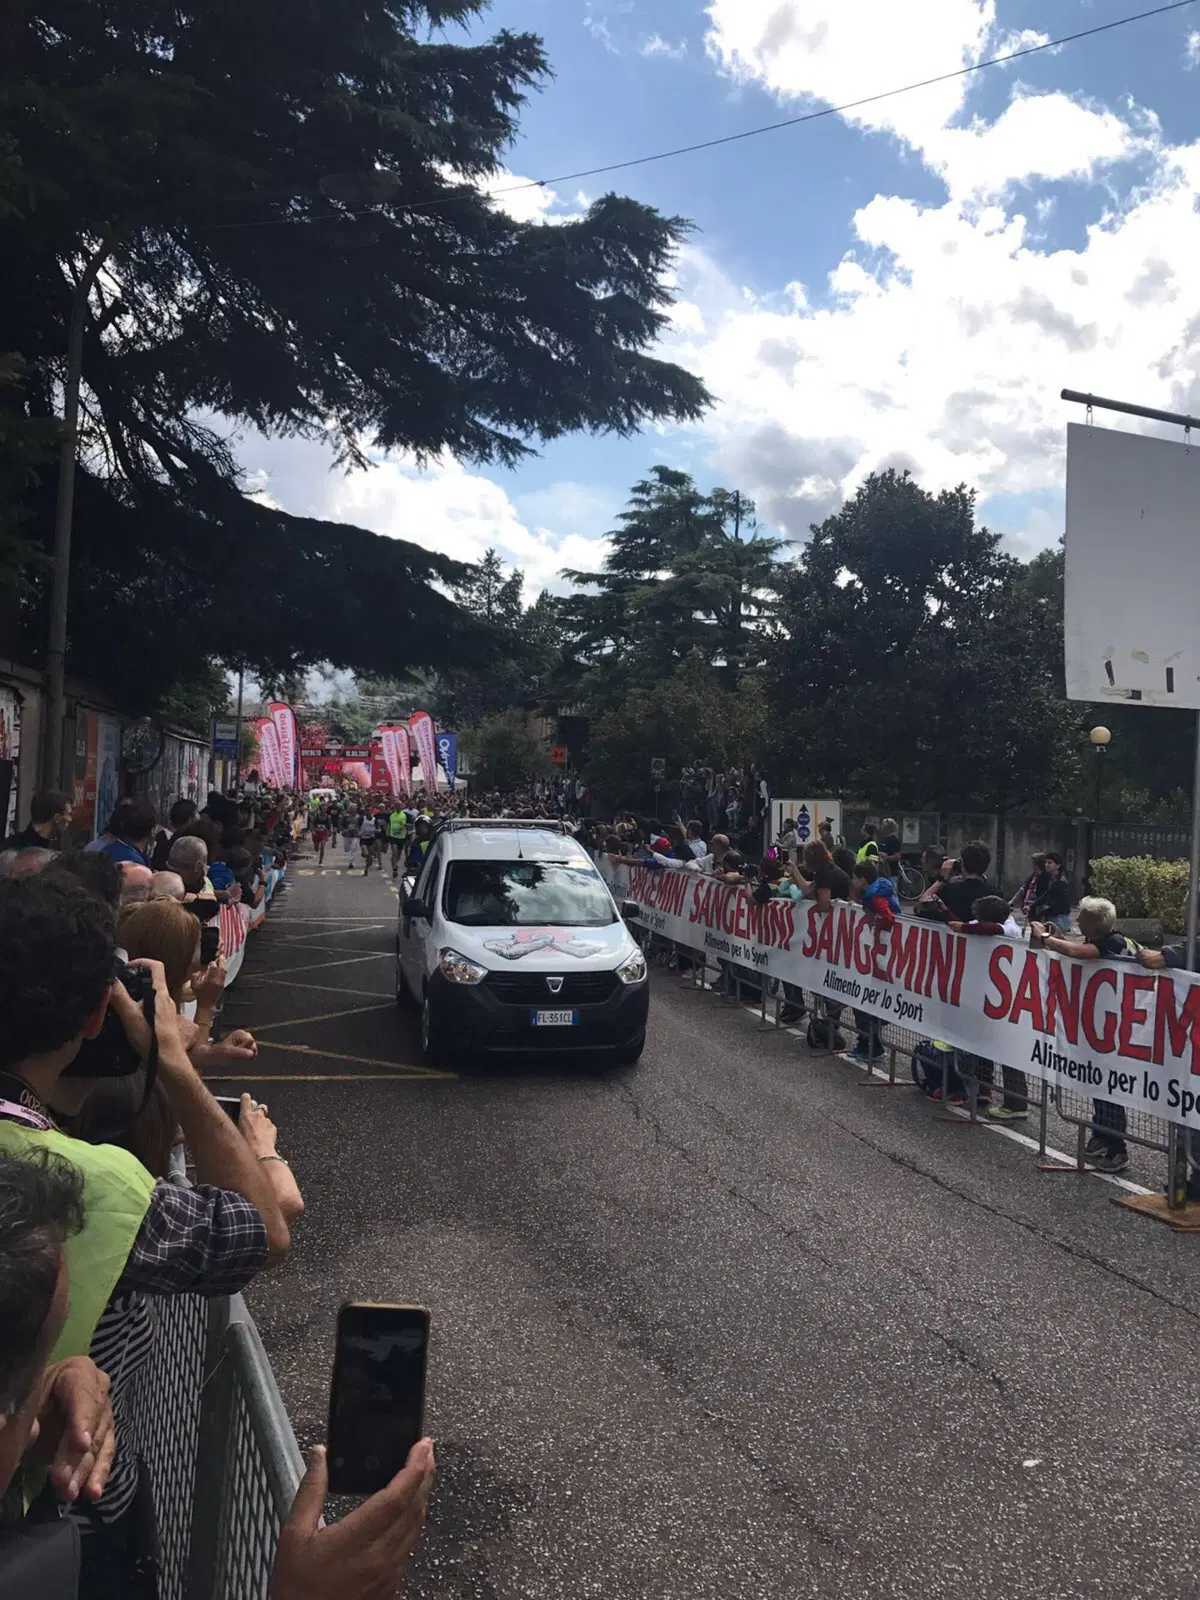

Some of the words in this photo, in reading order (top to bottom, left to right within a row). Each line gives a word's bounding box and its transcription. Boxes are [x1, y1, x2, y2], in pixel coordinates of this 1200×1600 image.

[689, 878, 796, 952] SANGEMINI
[704, 931, 729, 953] Alimento
[731, 944, 742, 958] per
[744, 944, 750, 960] lo
[751, 947, 768, 967] Sport
[802, 903, 967, 1008] SANGEMINI
[823, 969, 861, 998] Alimento
[861, 987, 881, 1005] per
[881, 989, 893, 1010] lo
[893, 993, 924, 1022] Sport
[1031, 1039, 1102, 1086] Alimento
[1107, 1069, 1137, 1095] per
[1143, 1071, 1160, 1101] lo
